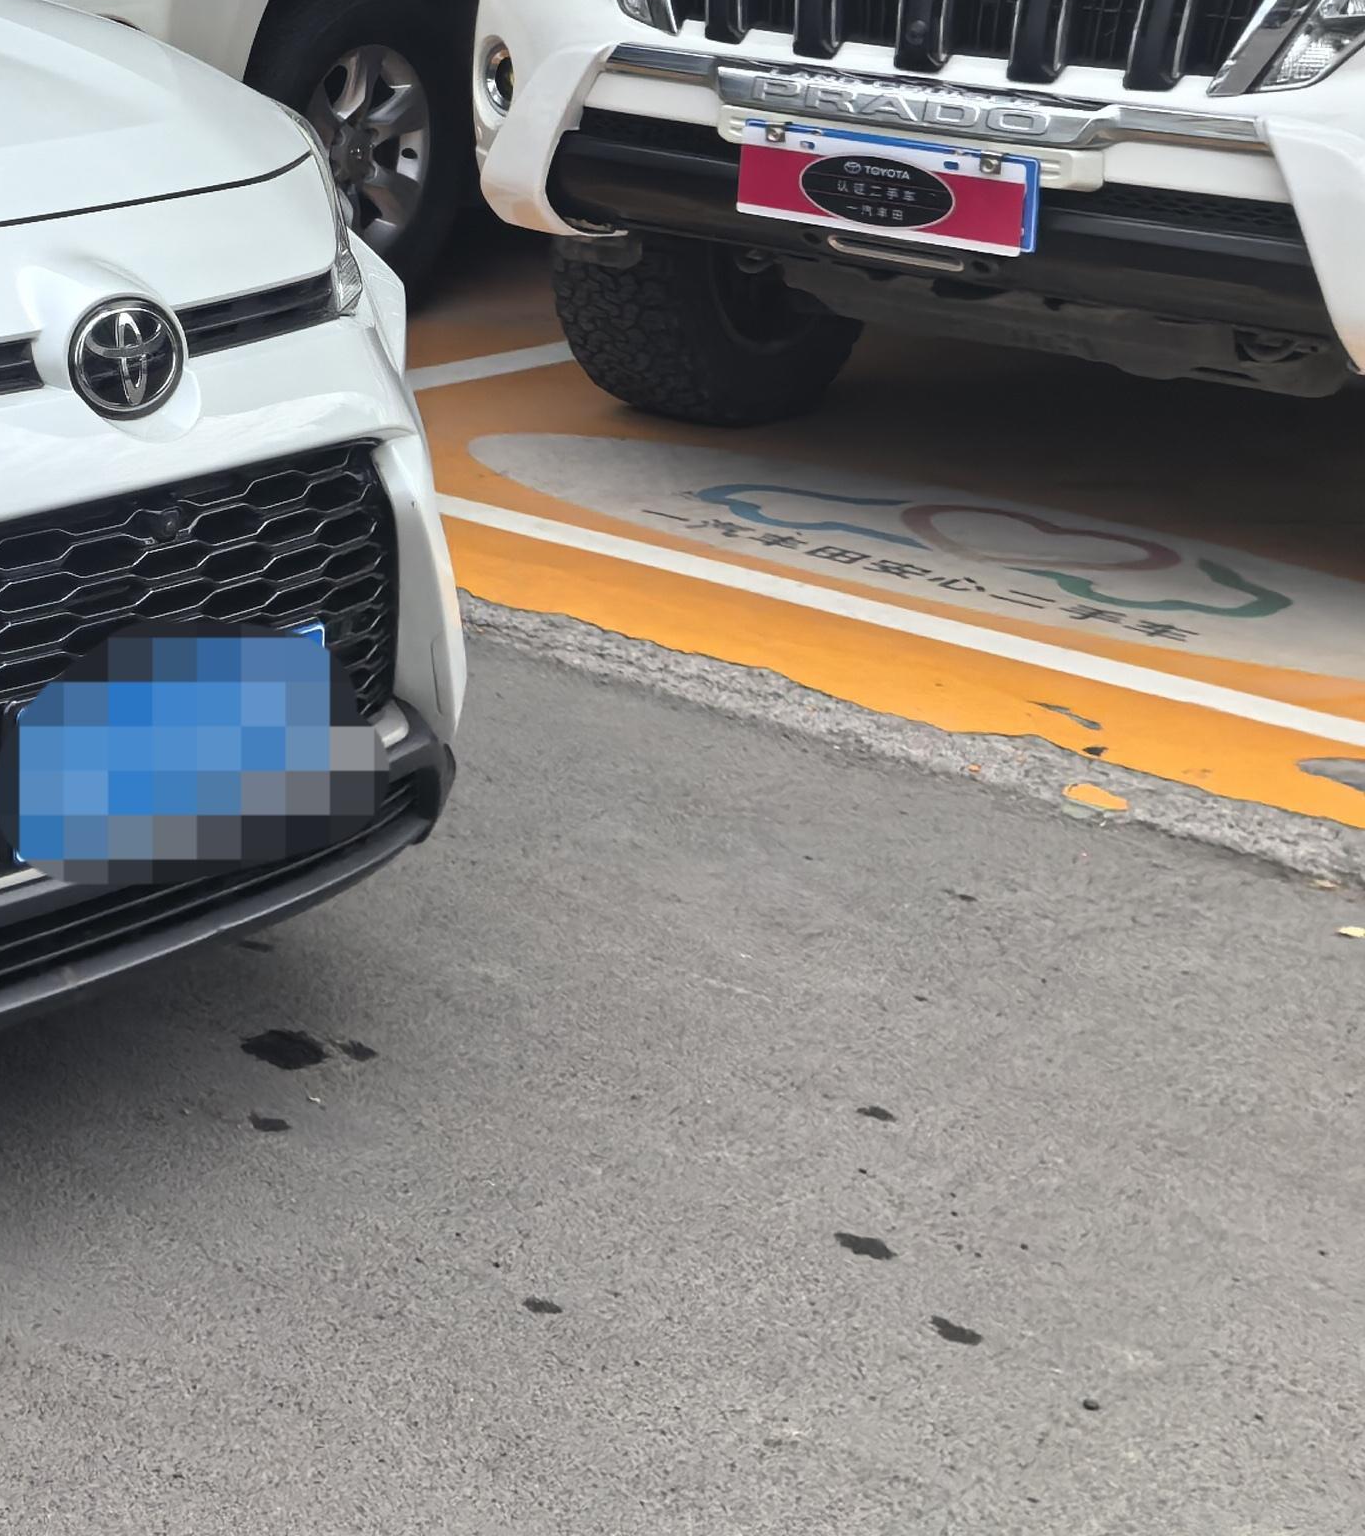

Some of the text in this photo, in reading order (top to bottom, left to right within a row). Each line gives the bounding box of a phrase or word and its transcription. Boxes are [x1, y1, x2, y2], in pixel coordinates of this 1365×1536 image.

[752, 75, 1052, 136] PRADO
[864, 165, 910, 181] TOYOTA
[642, 509, 1201, 644] 一汽丰田安心二手车
